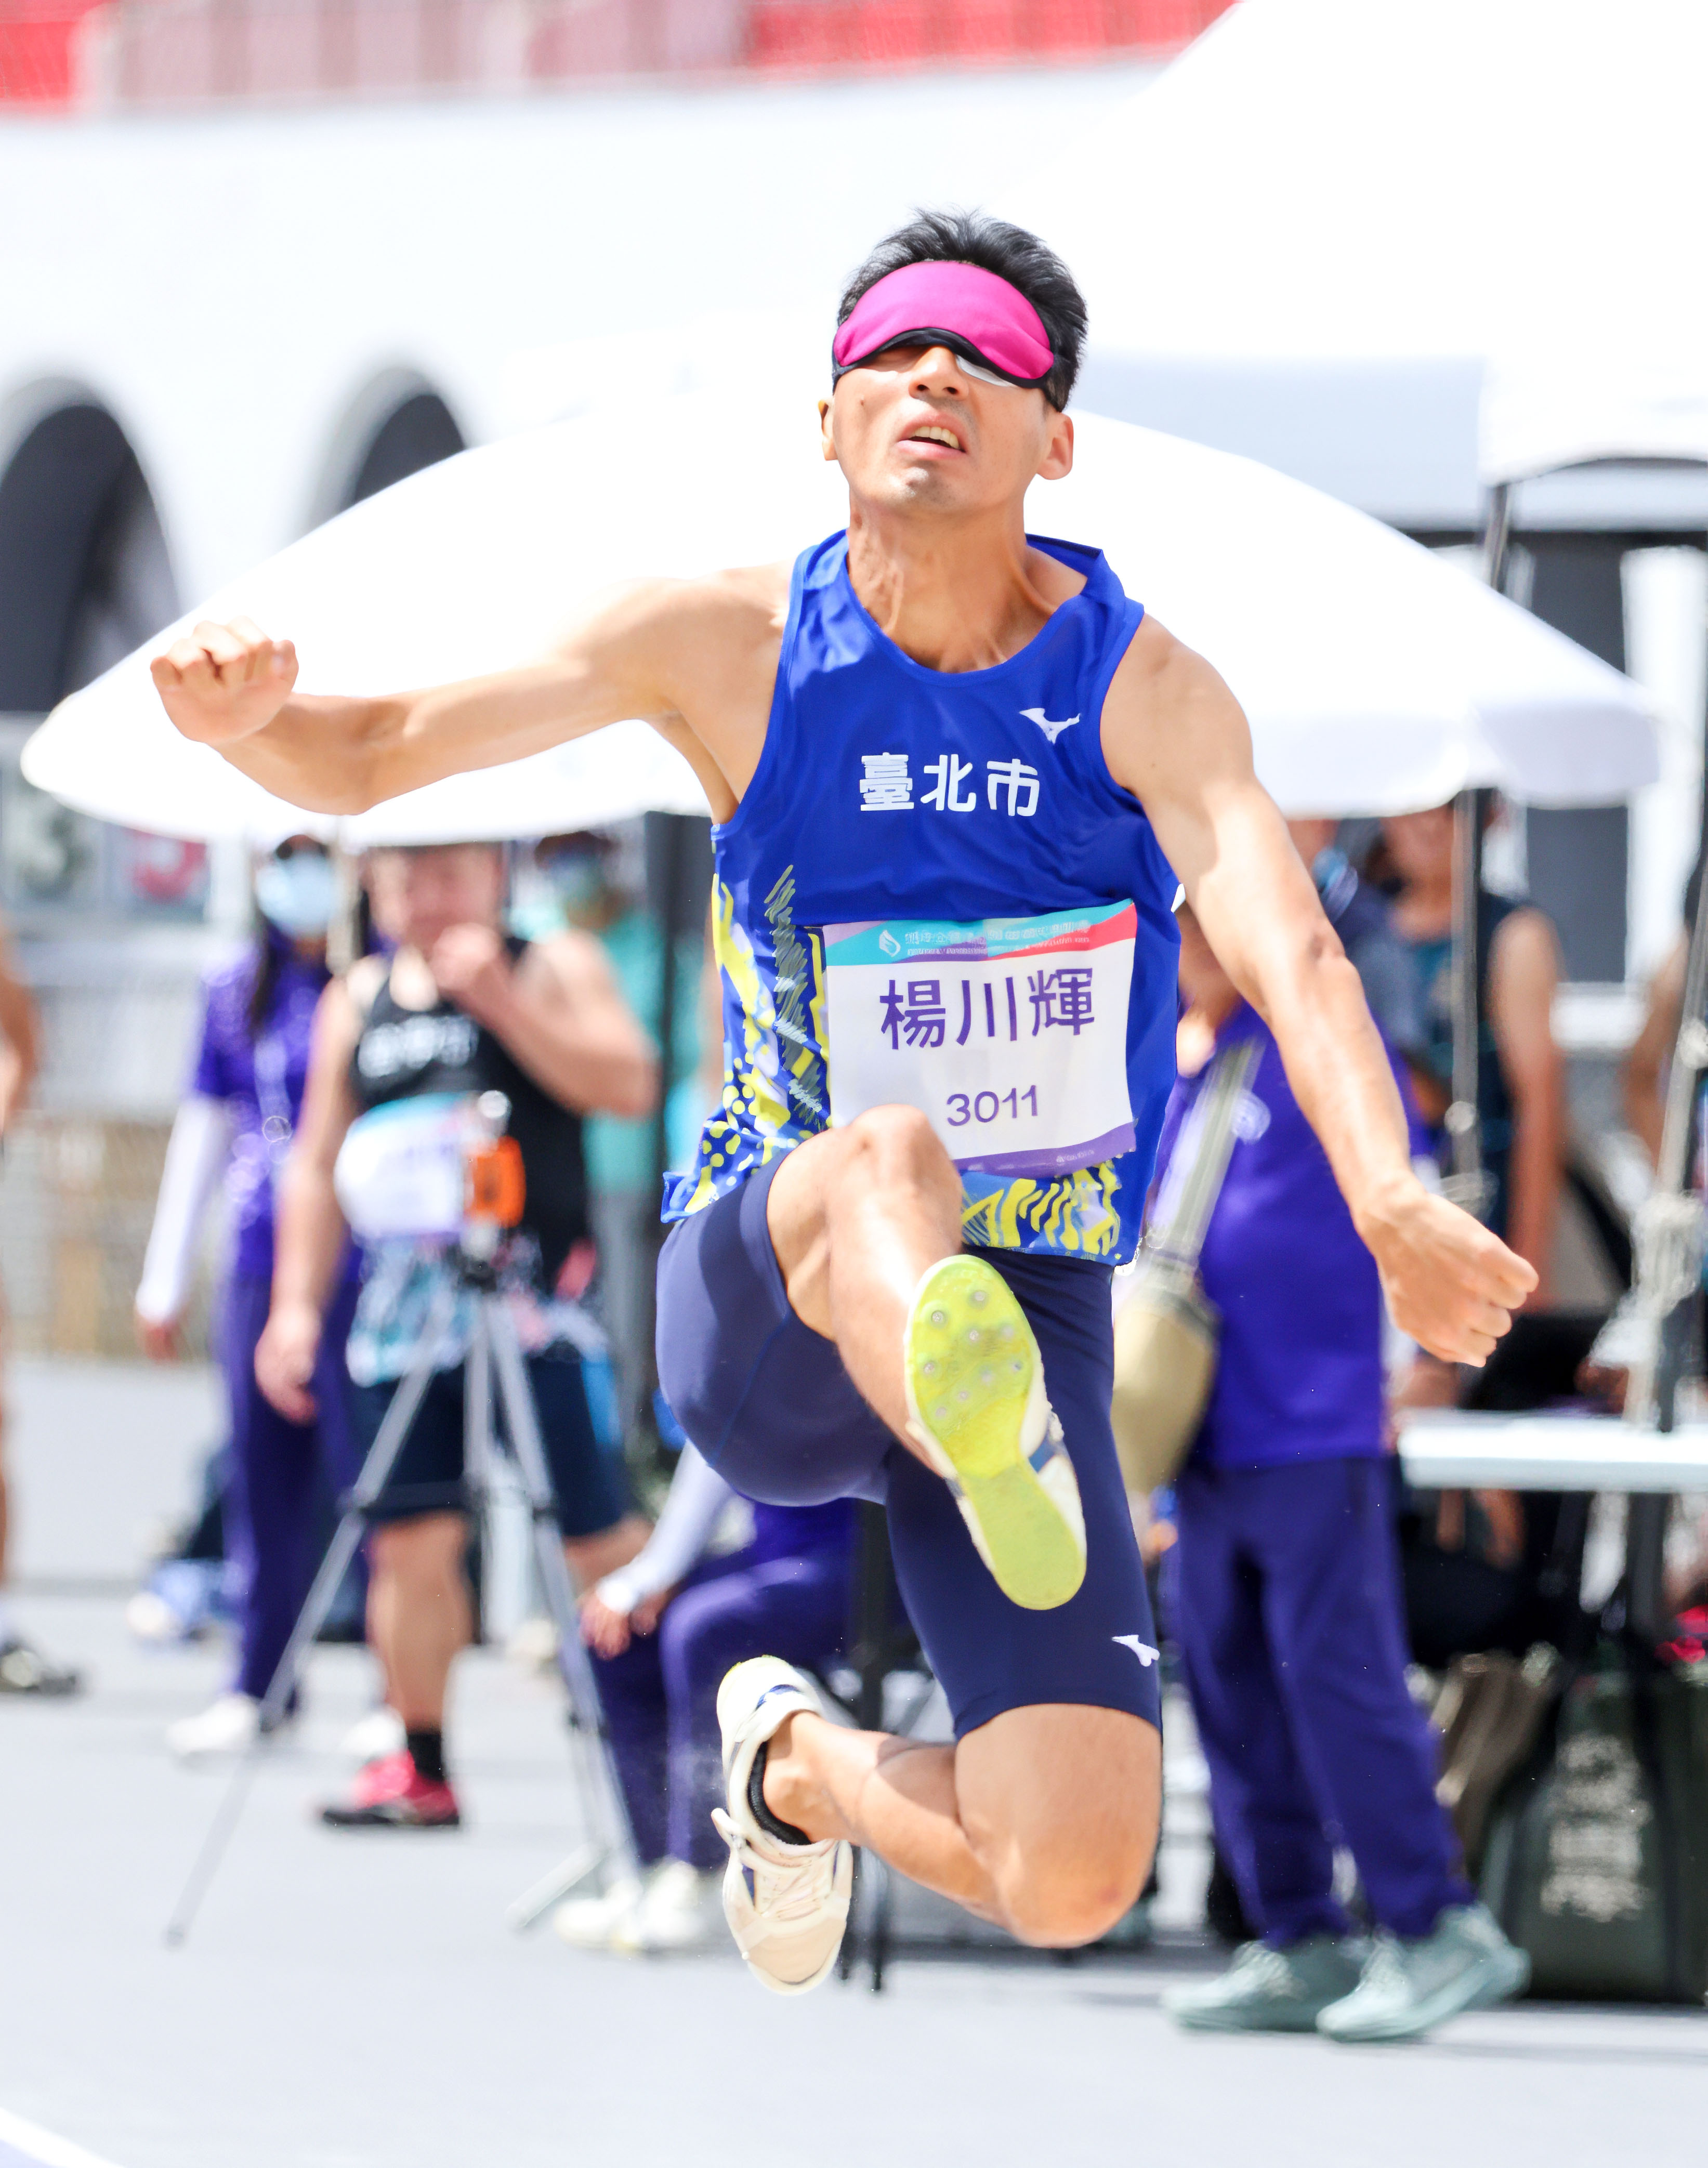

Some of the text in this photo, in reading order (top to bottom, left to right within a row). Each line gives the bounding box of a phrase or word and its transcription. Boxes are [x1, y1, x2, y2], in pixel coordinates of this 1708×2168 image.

[860, 752, 1040, 816] 臺北市
[879, 968, 1095, 1050] 楊川輝
[947, 1085, 1039, 1127] 3011
